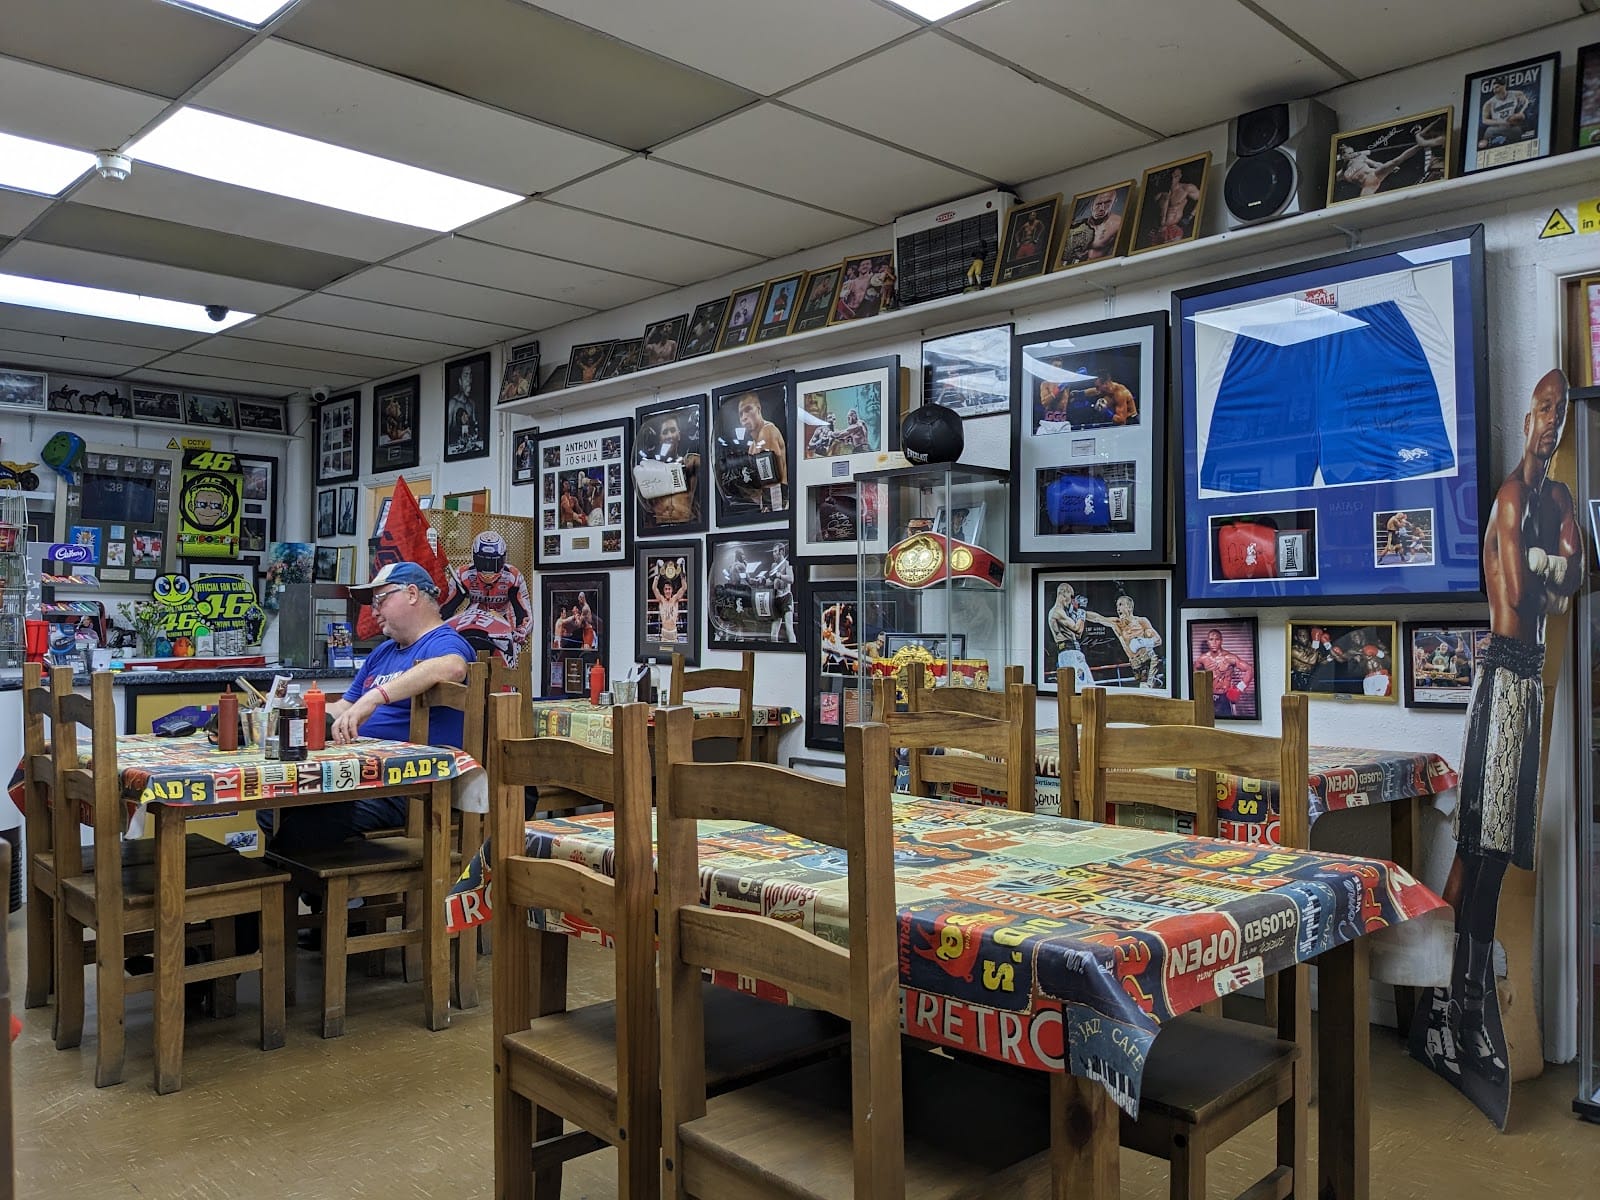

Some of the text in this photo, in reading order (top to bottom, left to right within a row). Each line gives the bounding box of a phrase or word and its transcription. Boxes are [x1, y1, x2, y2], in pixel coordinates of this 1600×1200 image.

[1482, 67, 1540, 93] GAEDAY
[1583, 219, 1594, 229] in
[565, 439, 598, 452] ANTHONY
[907, 448, 928, 462] EVERLAST
[190, 452, 235, 471] 46
[565, 453, 598, 466] JOSHUA
[1114, 490, 1124, 519] LONSDALE
[56, 549, 86, 560] Cadbury
[1284, 537, 1298, 571] LONSDALE
[195, 582, 247, 593] OFFICIAL FAN CLUB
[205, 593, 253, 619] 46
[160, 611, 198, 631] 46
[388, 757, 451, 785] DAD'S
[1359, 771, 1383, 784] CLOSED
[140, 779, 207, 804] DAD'S
[1328, 776, 1357, 793] OPEN
[1218, 820, 1281, 847] ETRO
[1244, 908, 1297, 943] CLOSED
[1169, 929, 1235, 979] OPEN
[916, 993, 1066, 1070] RETRO
[1111, 1027, 1144, 1072] CAFE
